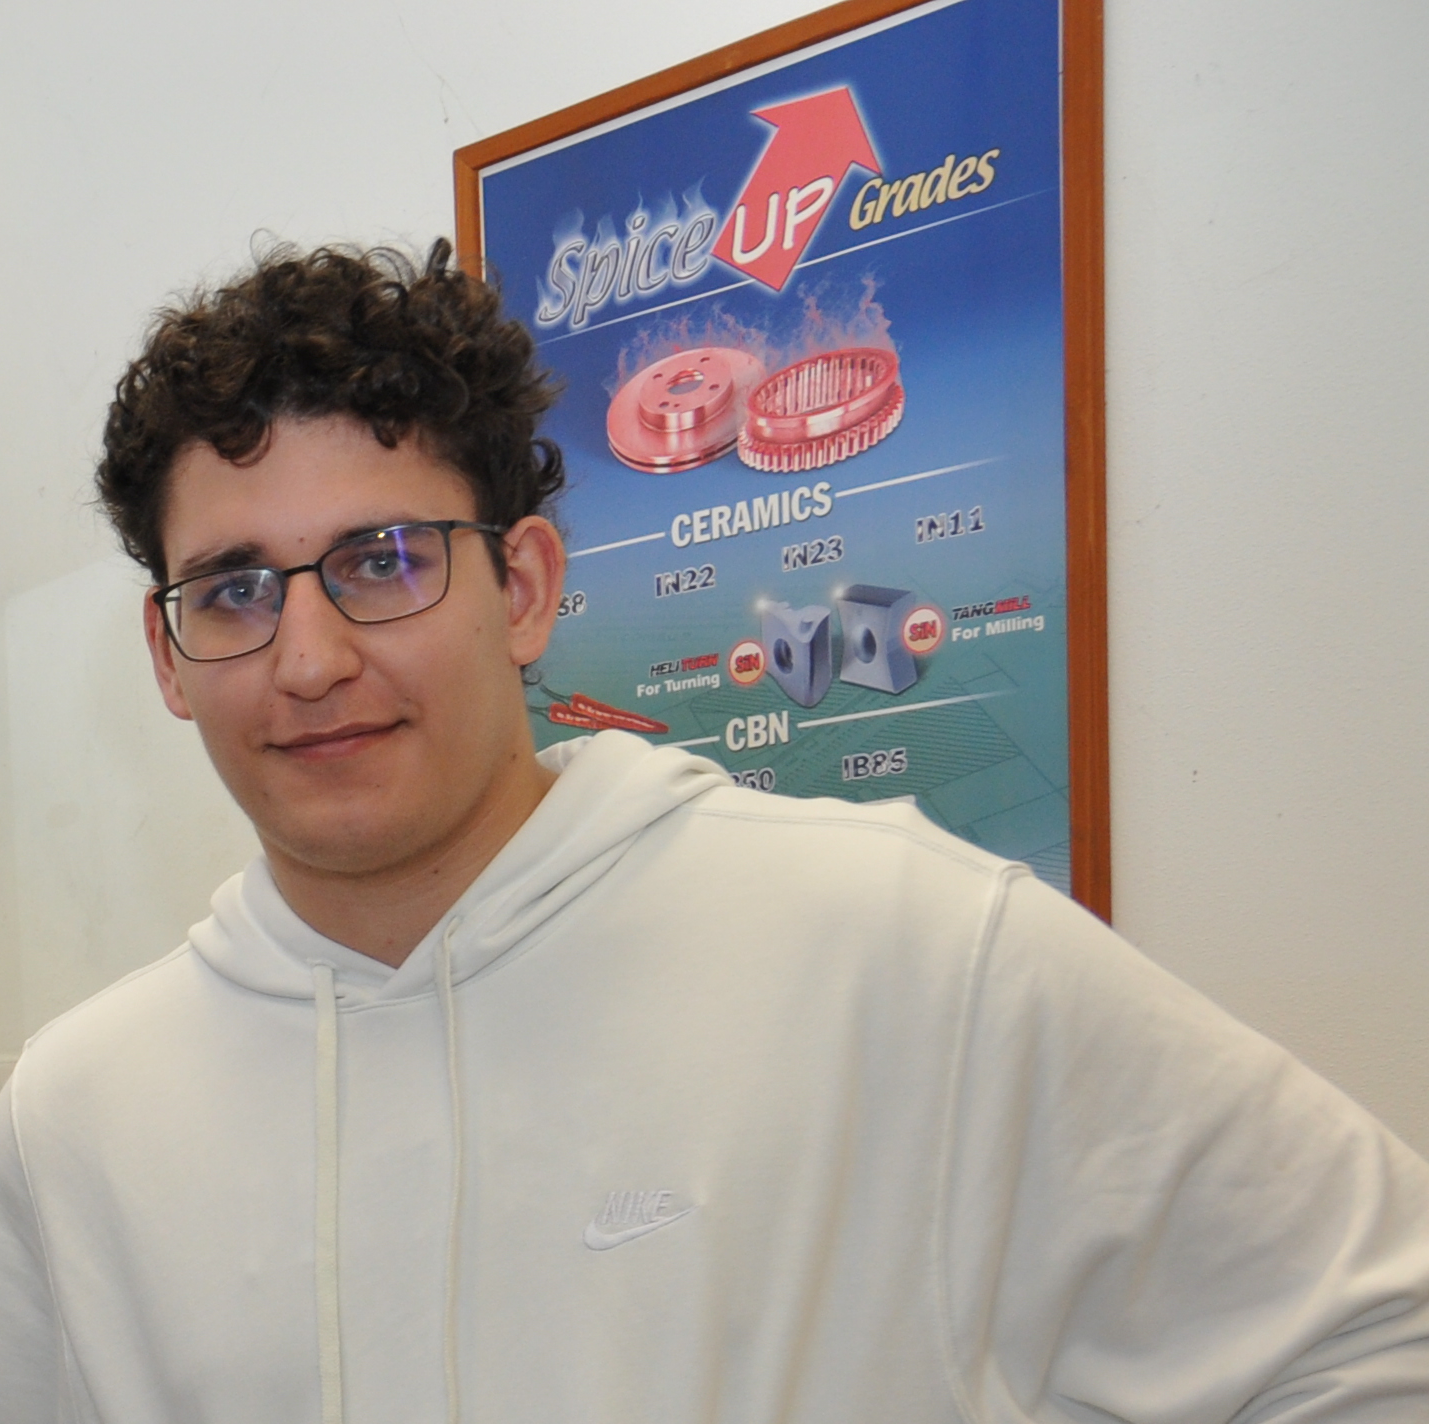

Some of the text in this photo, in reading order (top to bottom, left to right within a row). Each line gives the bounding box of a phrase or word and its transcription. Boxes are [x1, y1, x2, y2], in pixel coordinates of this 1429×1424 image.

[538, 148, 1000, 326] Spice UP Grades
[670, 481, 833, 548] CERAMICS
[916, 505, 985, 543] IN11
[782, 535, 844, 571] IN23
[655, 564, 716, 598] IN22
[952, 615, 1045, 642] For Milling
[637, 673, 721, 698] For Turning
[725, 710, 790, 751] CBN
[842, 748, 908, 780] IB85
[600, 1190, 675, 1225] NIKE
